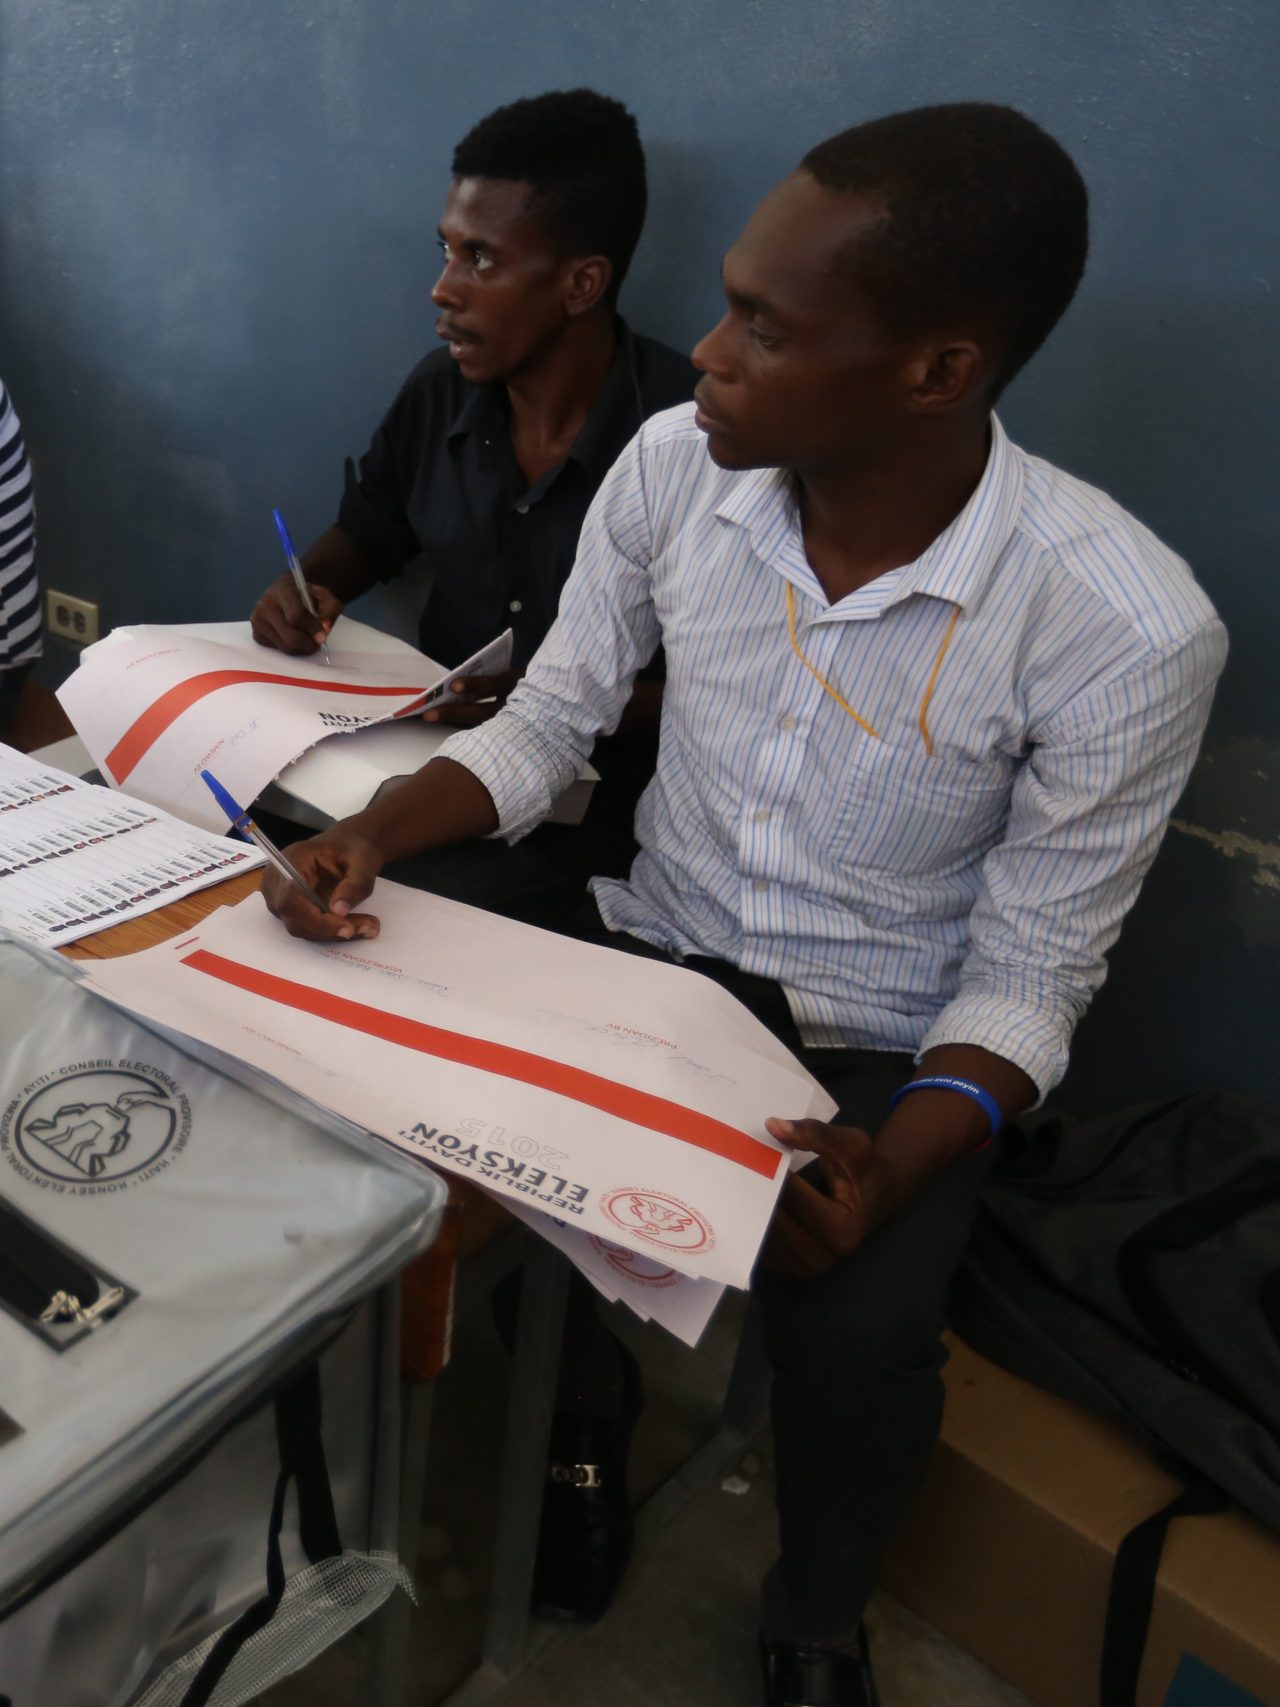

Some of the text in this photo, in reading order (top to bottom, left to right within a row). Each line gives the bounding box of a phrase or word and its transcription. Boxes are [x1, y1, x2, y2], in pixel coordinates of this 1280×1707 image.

[622, 1026, 678, 1050] PREZIDAN
[23, 1074, 50, 1096] AYITI
[59, 1058, 114, 1075] CONSEIL
[118, 1058, 179, 1094] ELECTORAL
[952, 1080, 979, 1094] peyim
[176, 1093, 193, 1155] PROVISOIRE
[397, 1130, 473, 1168] DAYITI
[411, 1122, 590, 1203] ELEKSYON
[455, 1118, 569, 1170] 2015
[6, 1152, 66, 1193] ELEKTORAL
[476, 1166, 585, 1215] REPIBLIK
